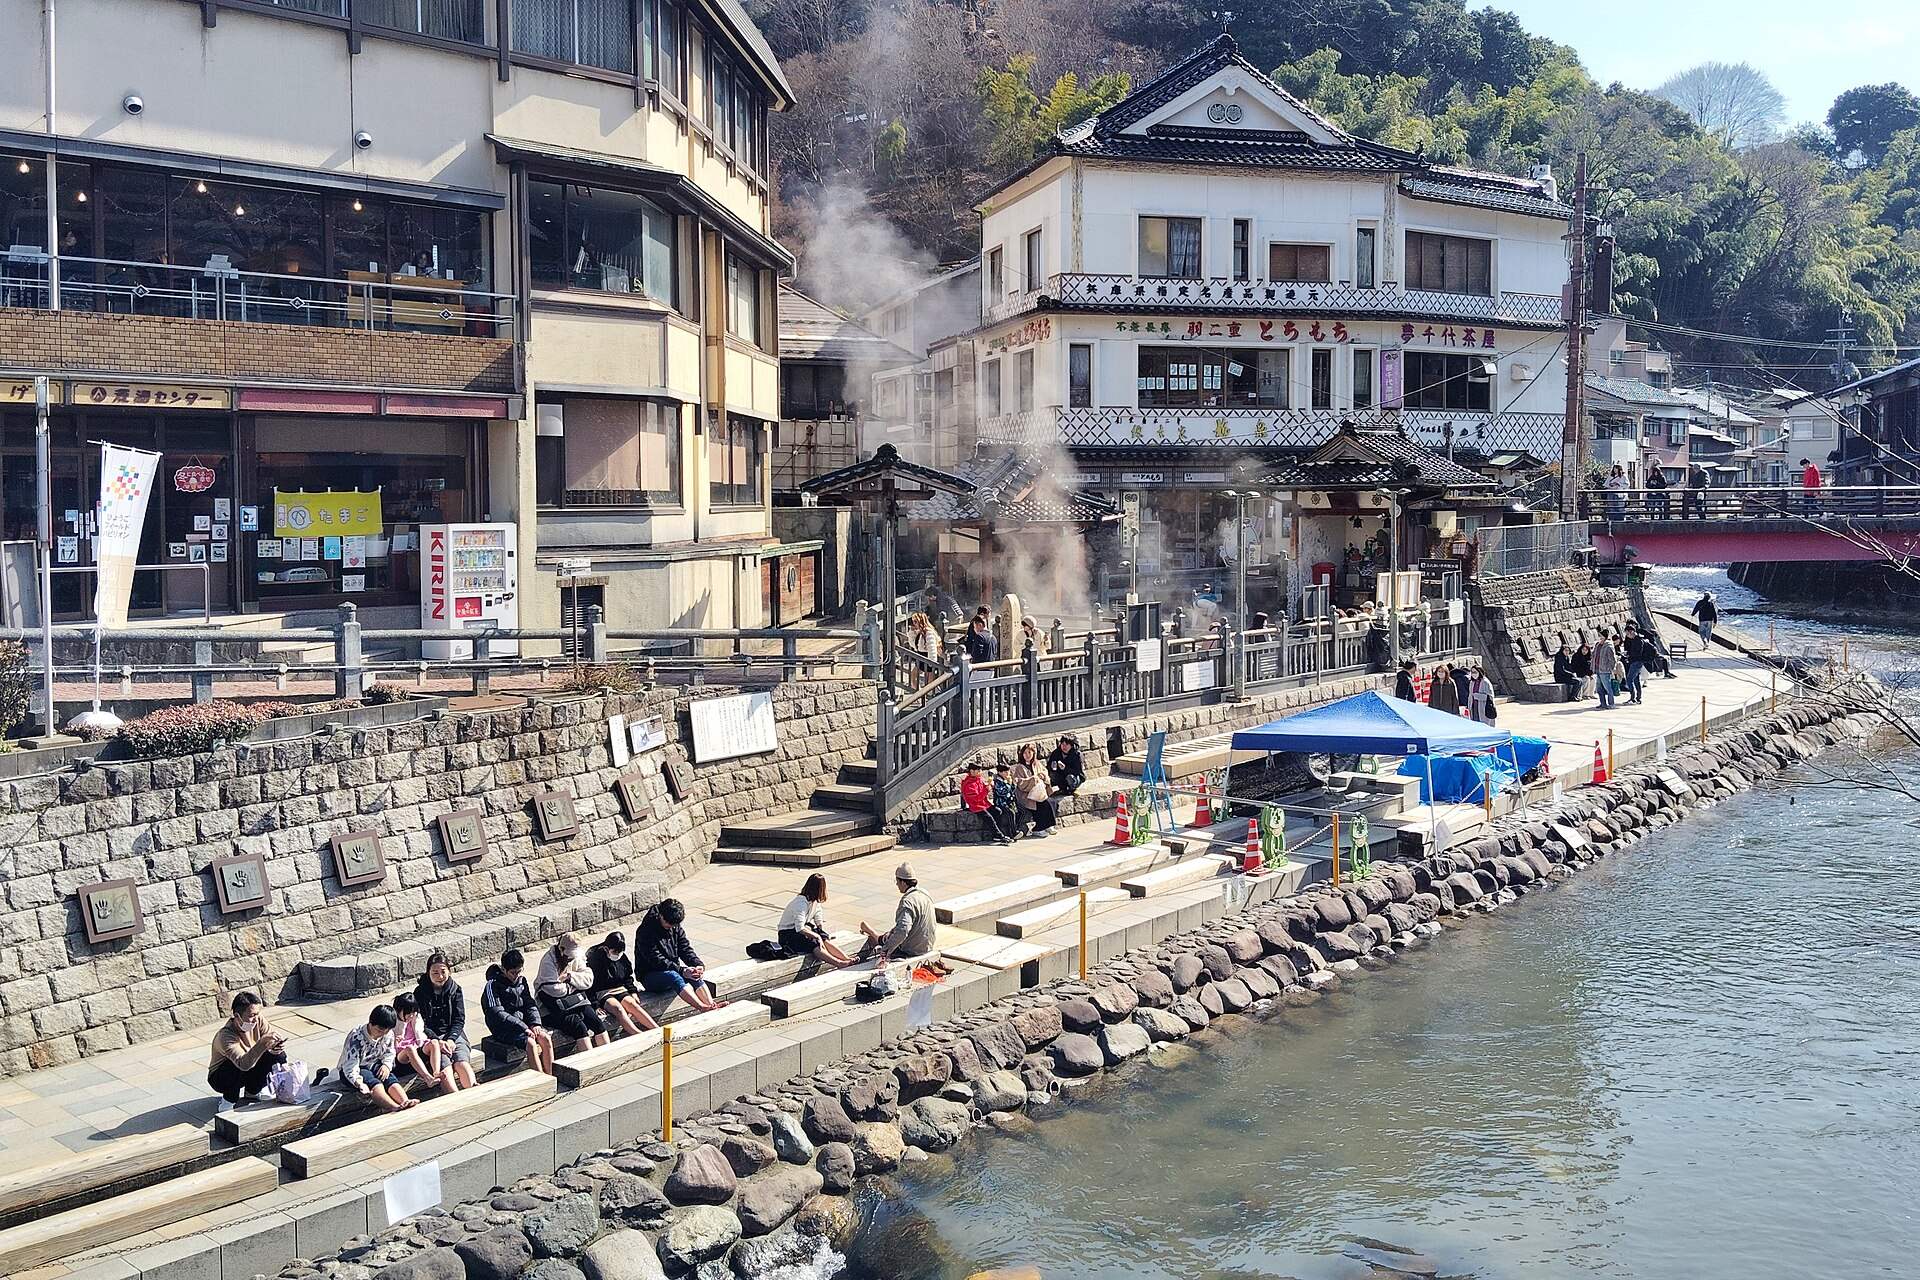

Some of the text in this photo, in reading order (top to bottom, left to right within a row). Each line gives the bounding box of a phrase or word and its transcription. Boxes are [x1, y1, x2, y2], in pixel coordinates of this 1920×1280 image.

[1187, 321, 1242, 338] 羽二重
[1258, 320, 1351, 343] とちもち
[1401, 322, 1496, 349] 夢千代茶屋
[318, 507, 369, 525] たまご
[430, 531, 445, 620] KIRIN
